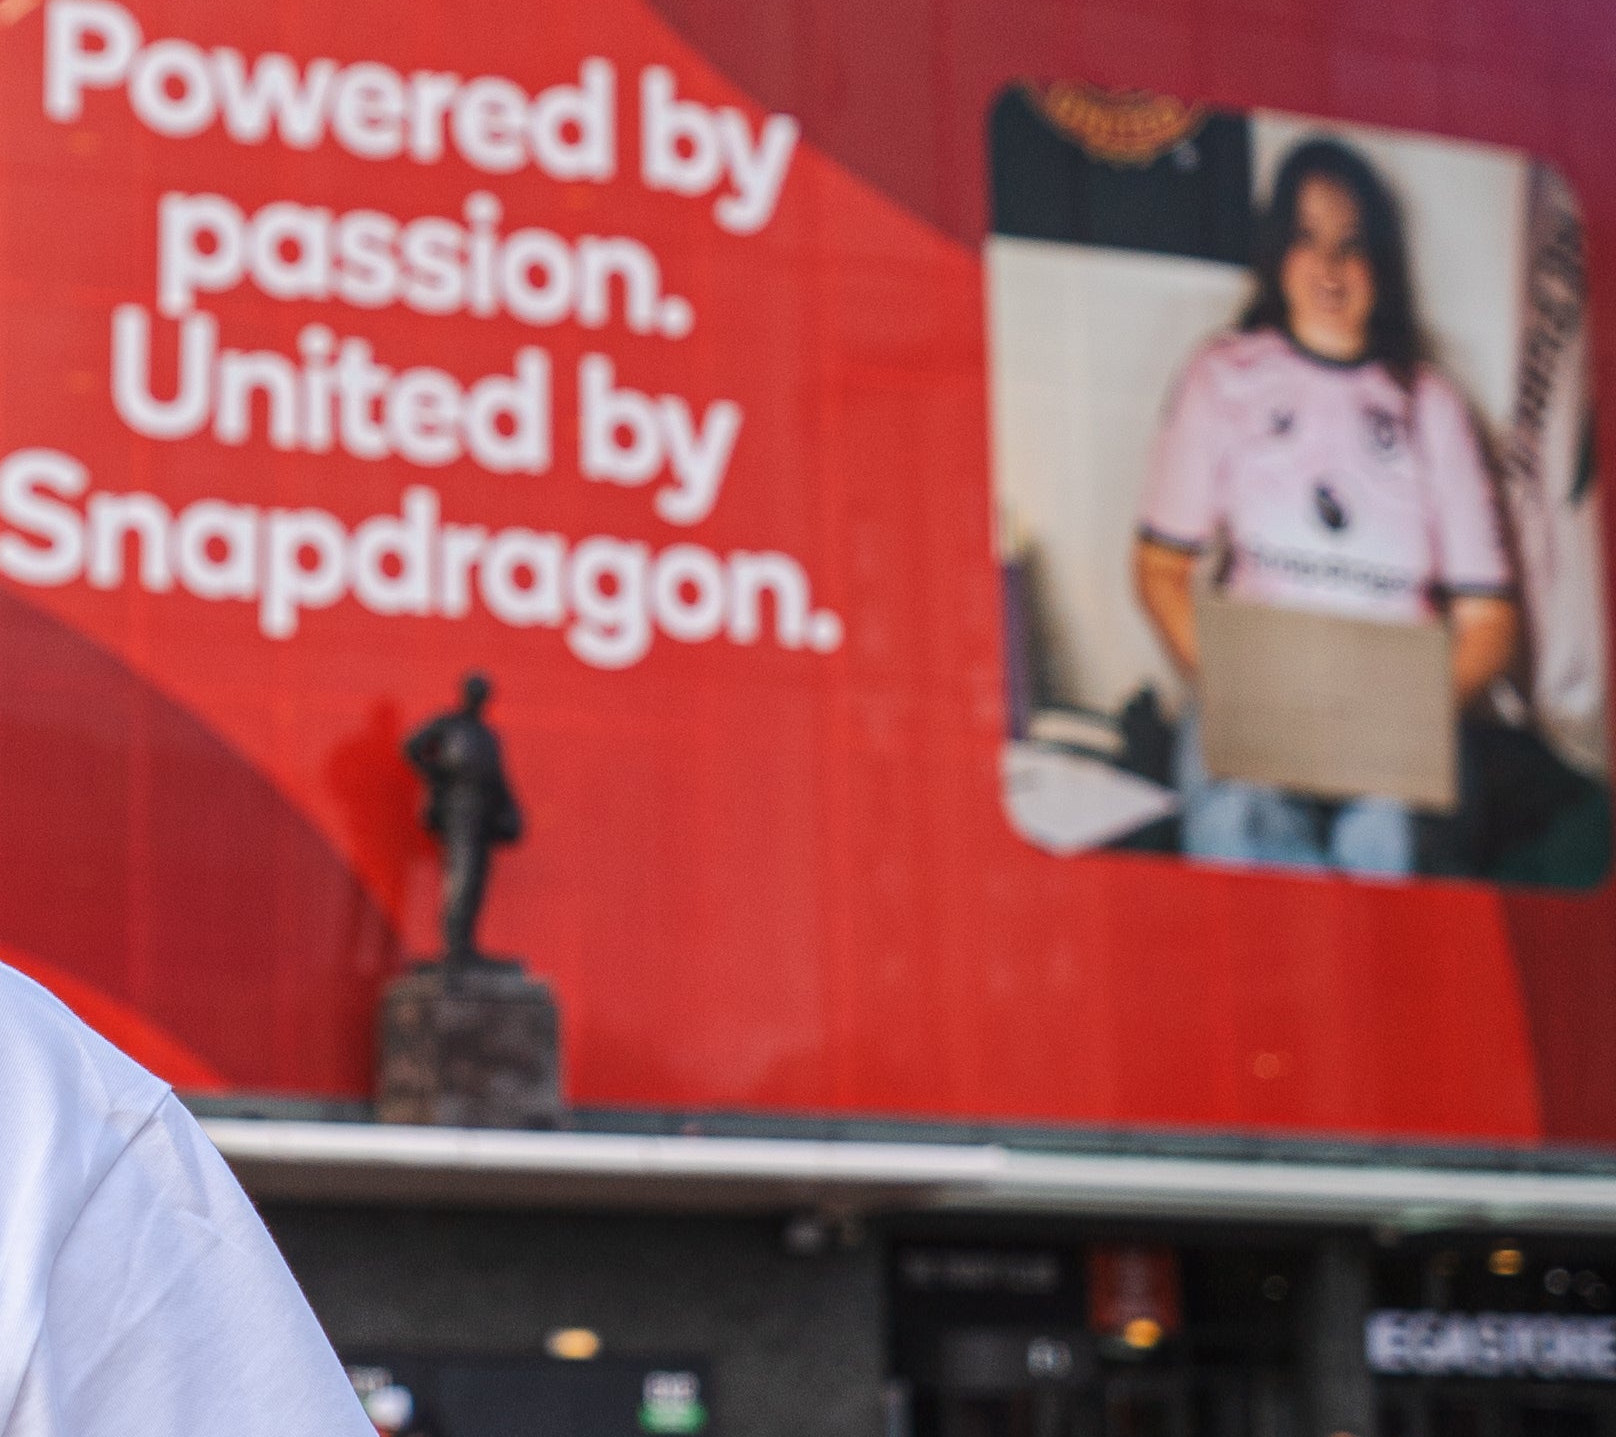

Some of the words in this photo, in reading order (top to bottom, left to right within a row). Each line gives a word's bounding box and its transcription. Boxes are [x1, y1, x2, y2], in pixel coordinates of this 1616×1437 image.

[640, 66, 798, 234] by
[156, 192, 693, 339] passion.
[109, 305, 550, 474] United
[580, 356, 741, 523] by
